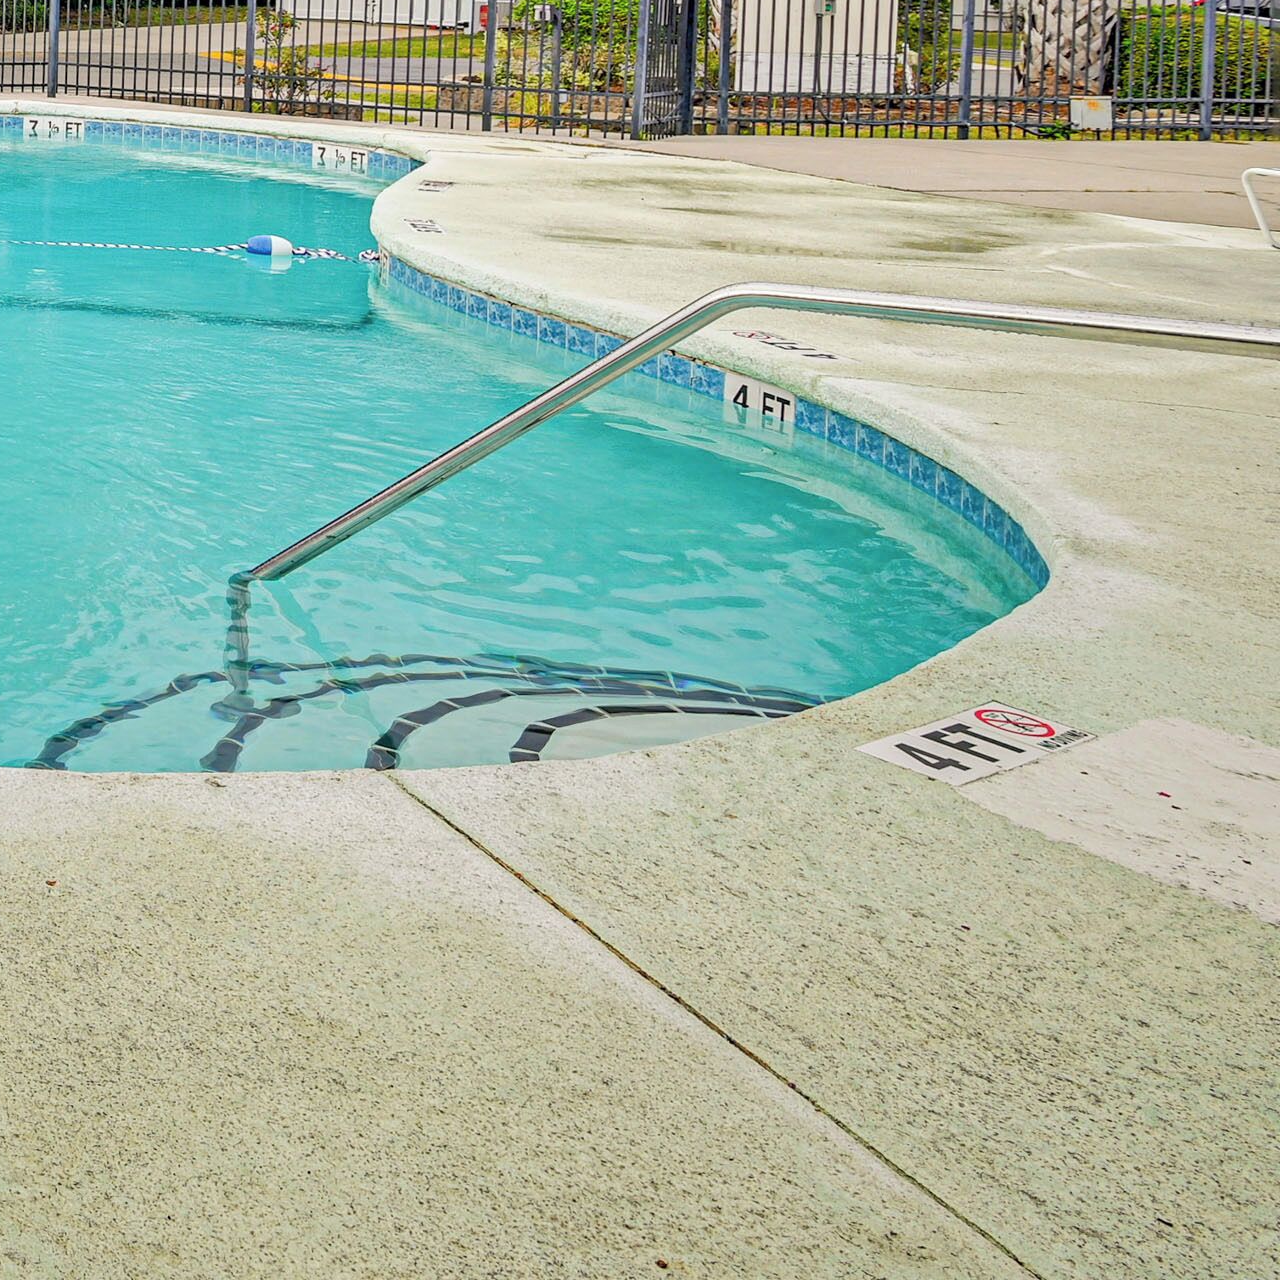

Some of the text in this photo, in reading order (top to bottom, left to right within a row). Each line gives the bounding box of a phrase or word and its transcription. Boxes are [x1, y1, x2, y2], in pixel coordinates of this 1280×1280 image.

[65, 122, 82, 137] FT
[351, 151, 366, 170] FT
[732, 384, 790, 422] 4 FT
[894, 722, 1027, 771] 4 FT
